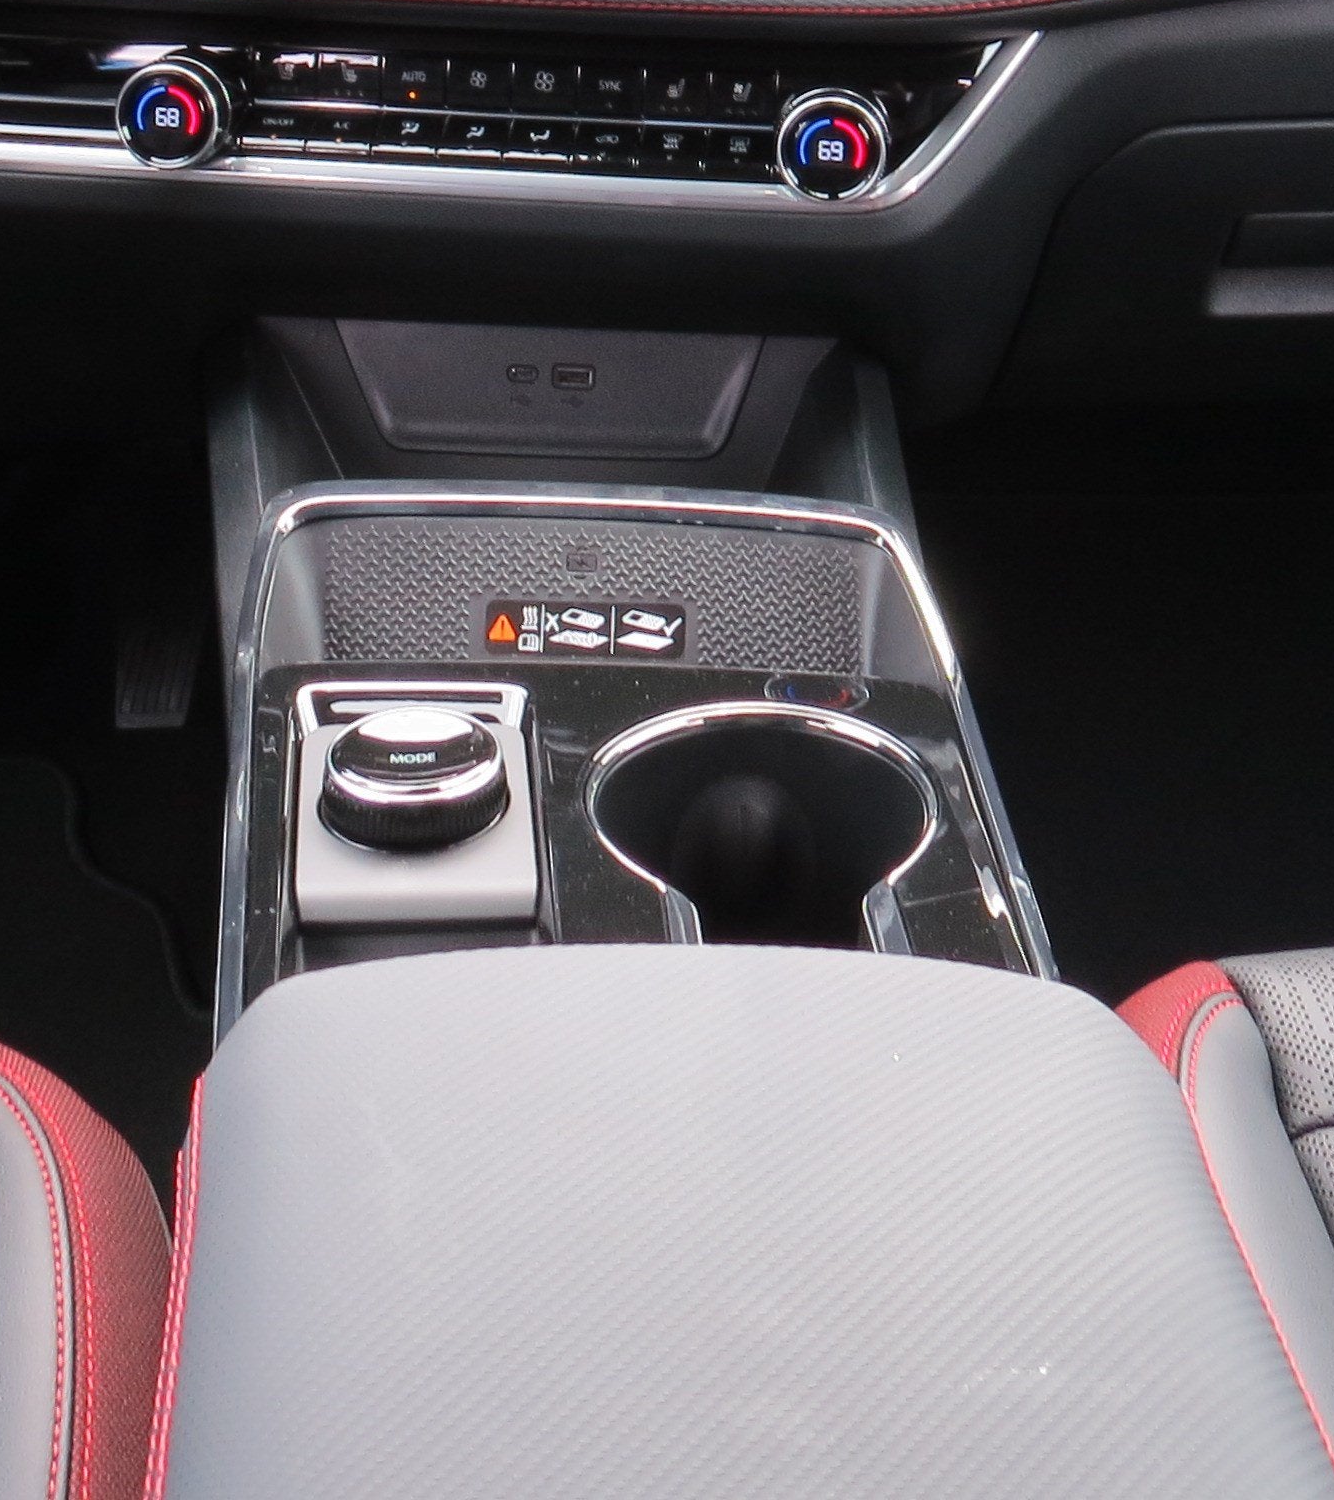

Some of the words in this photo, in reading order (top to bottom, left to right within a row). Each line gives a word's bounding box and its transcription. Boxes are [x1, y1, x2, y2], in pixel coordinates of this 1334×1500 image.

[401, 70, 428, 84] AUTO
[155, 107, 180, 128] 68
[818, 139, 844, 162] 69
[389, 750, 437, 765] MODE
